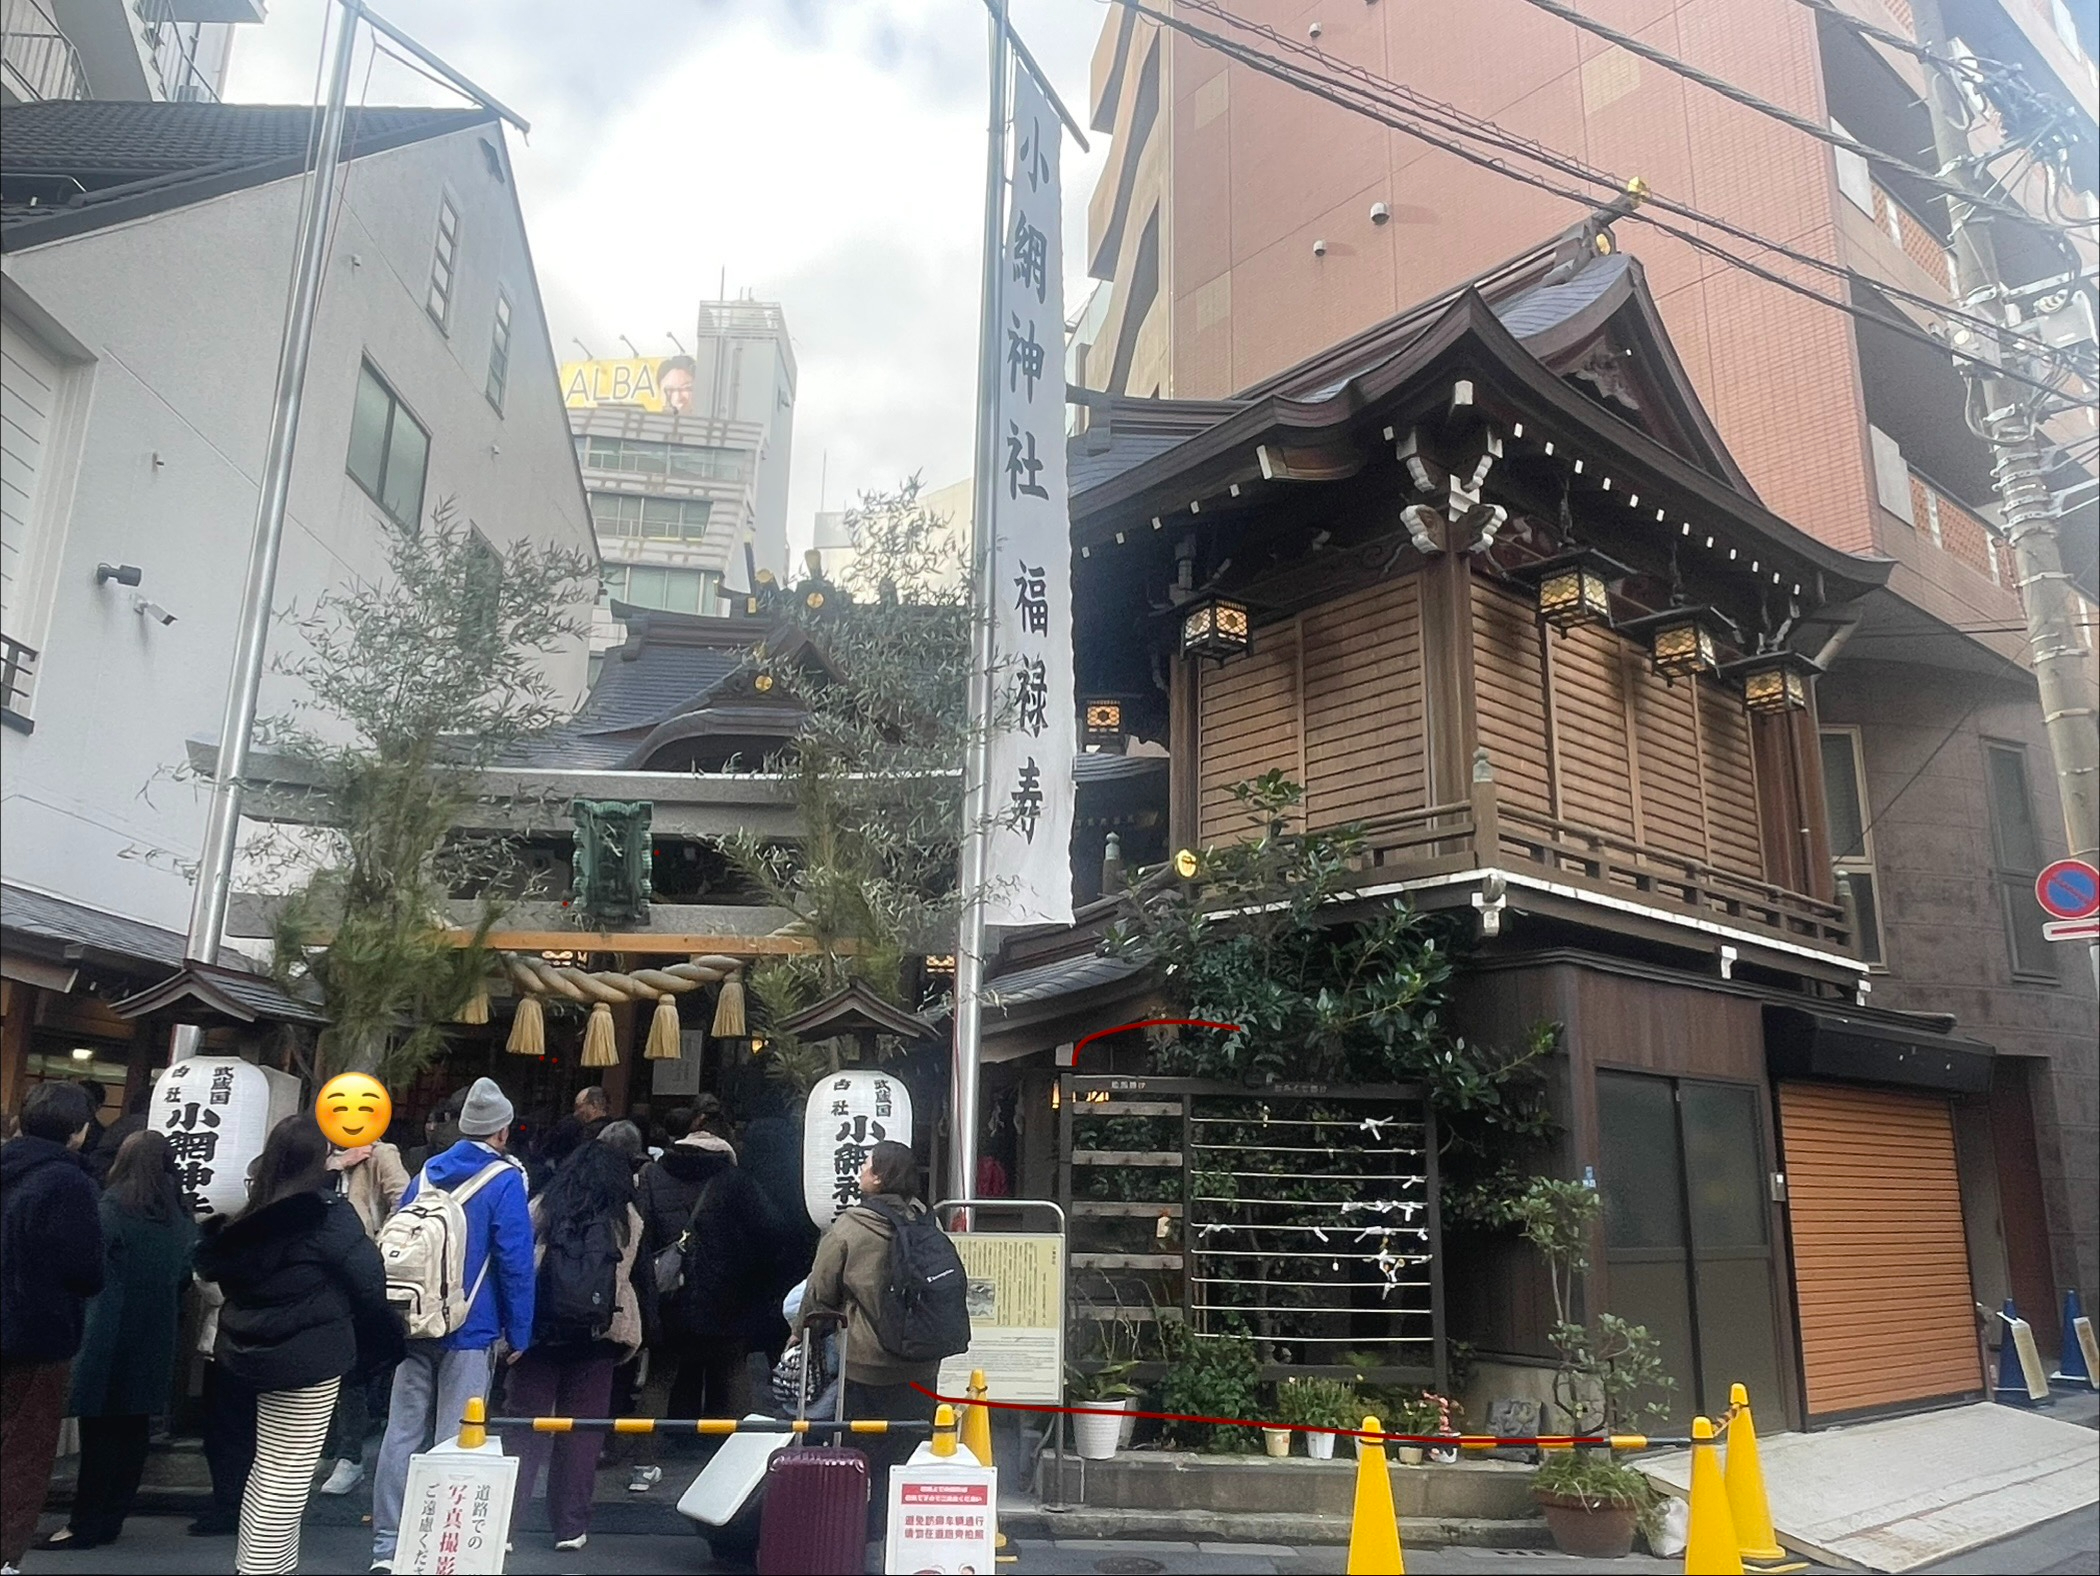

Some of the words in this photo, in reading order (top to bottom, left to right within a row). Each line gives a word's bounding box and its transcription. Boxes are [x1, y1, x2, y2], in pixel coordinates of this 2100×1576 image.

[1005, 116, 1049, 500] 小網神社
[566, 364, 655, 402] ALBA
[1013, 559, 1048, 846] 福禄寿
[435, 1484, 468, 1575] 写真撮影
[468, 1484, 491, 1550] 道路での
